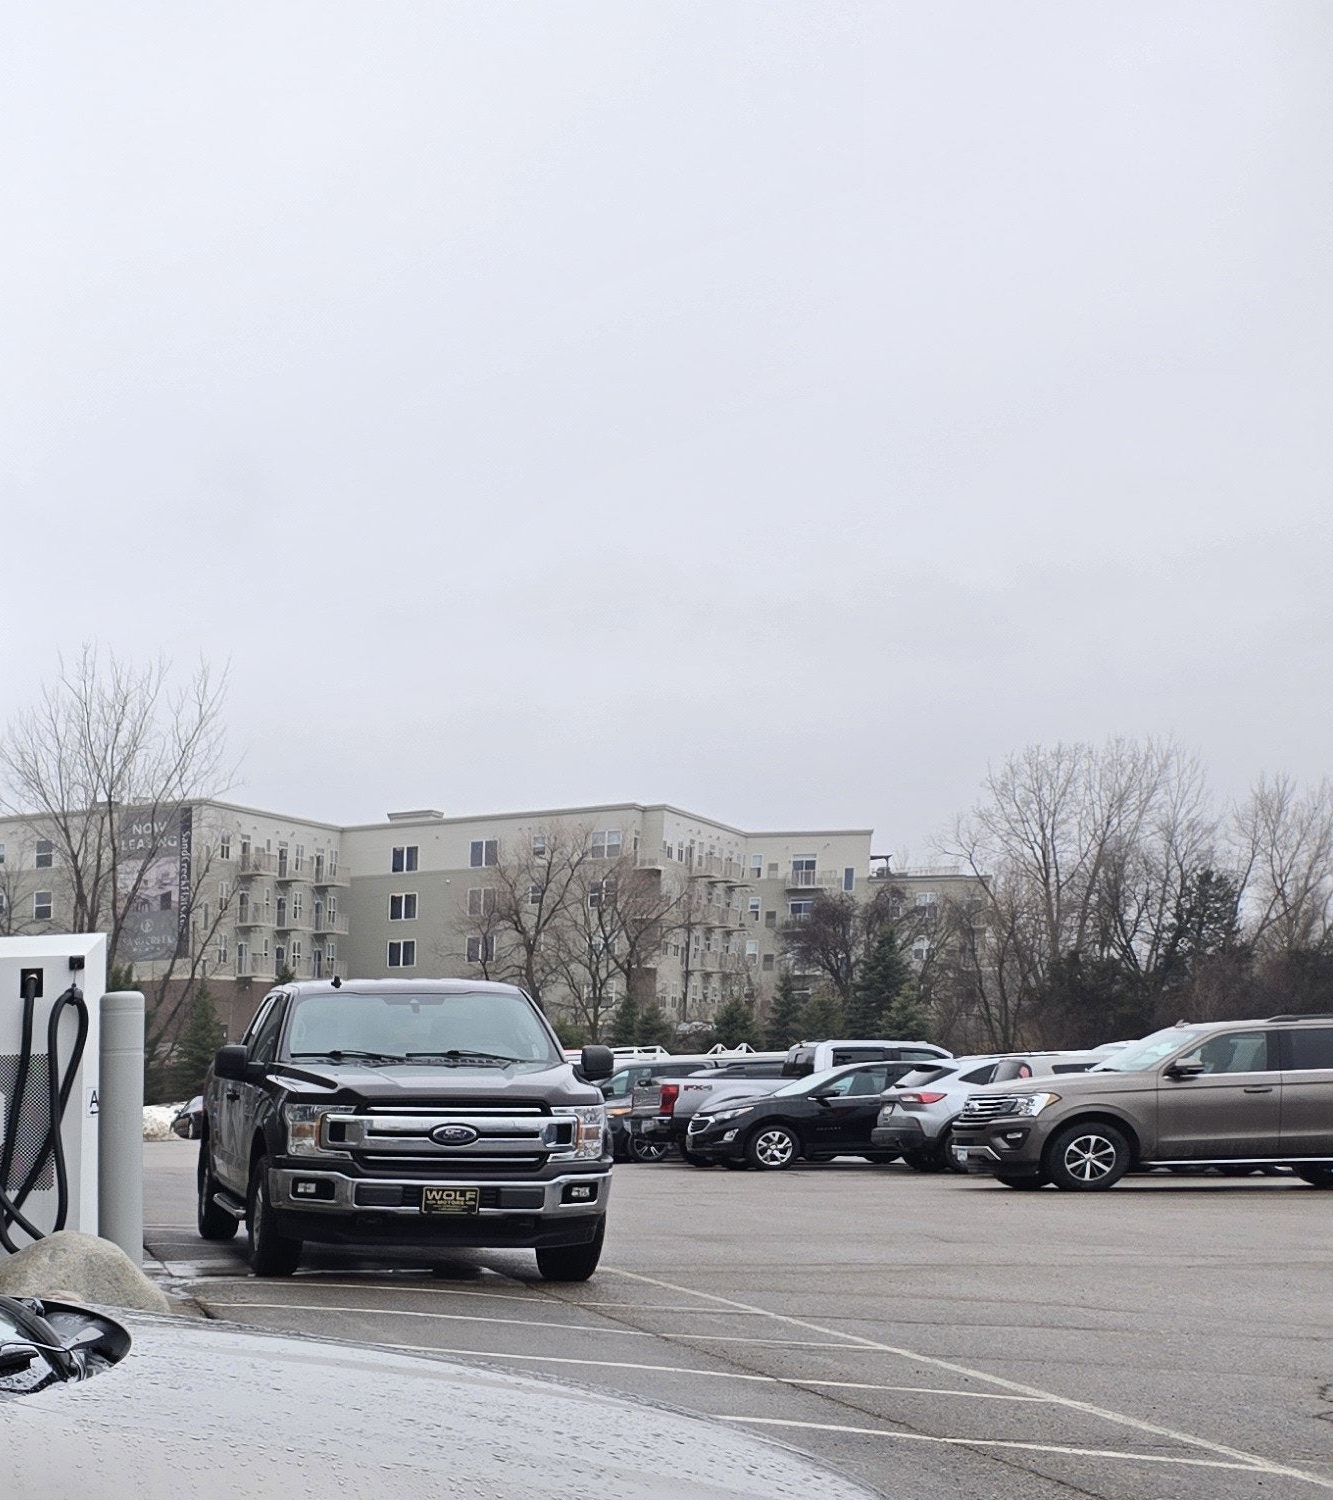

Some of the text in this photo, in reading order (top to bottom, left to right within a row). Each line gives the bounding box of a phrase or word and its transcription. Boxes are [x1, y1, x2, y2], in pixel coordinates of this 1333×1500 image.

[132, 821, 168, 835] NOW
[121, 835, 178, 851] LEASNG
[180, 830, 191, 932] SandCreekFlats.c
[426, 1190, 476, 1200] WOLF
